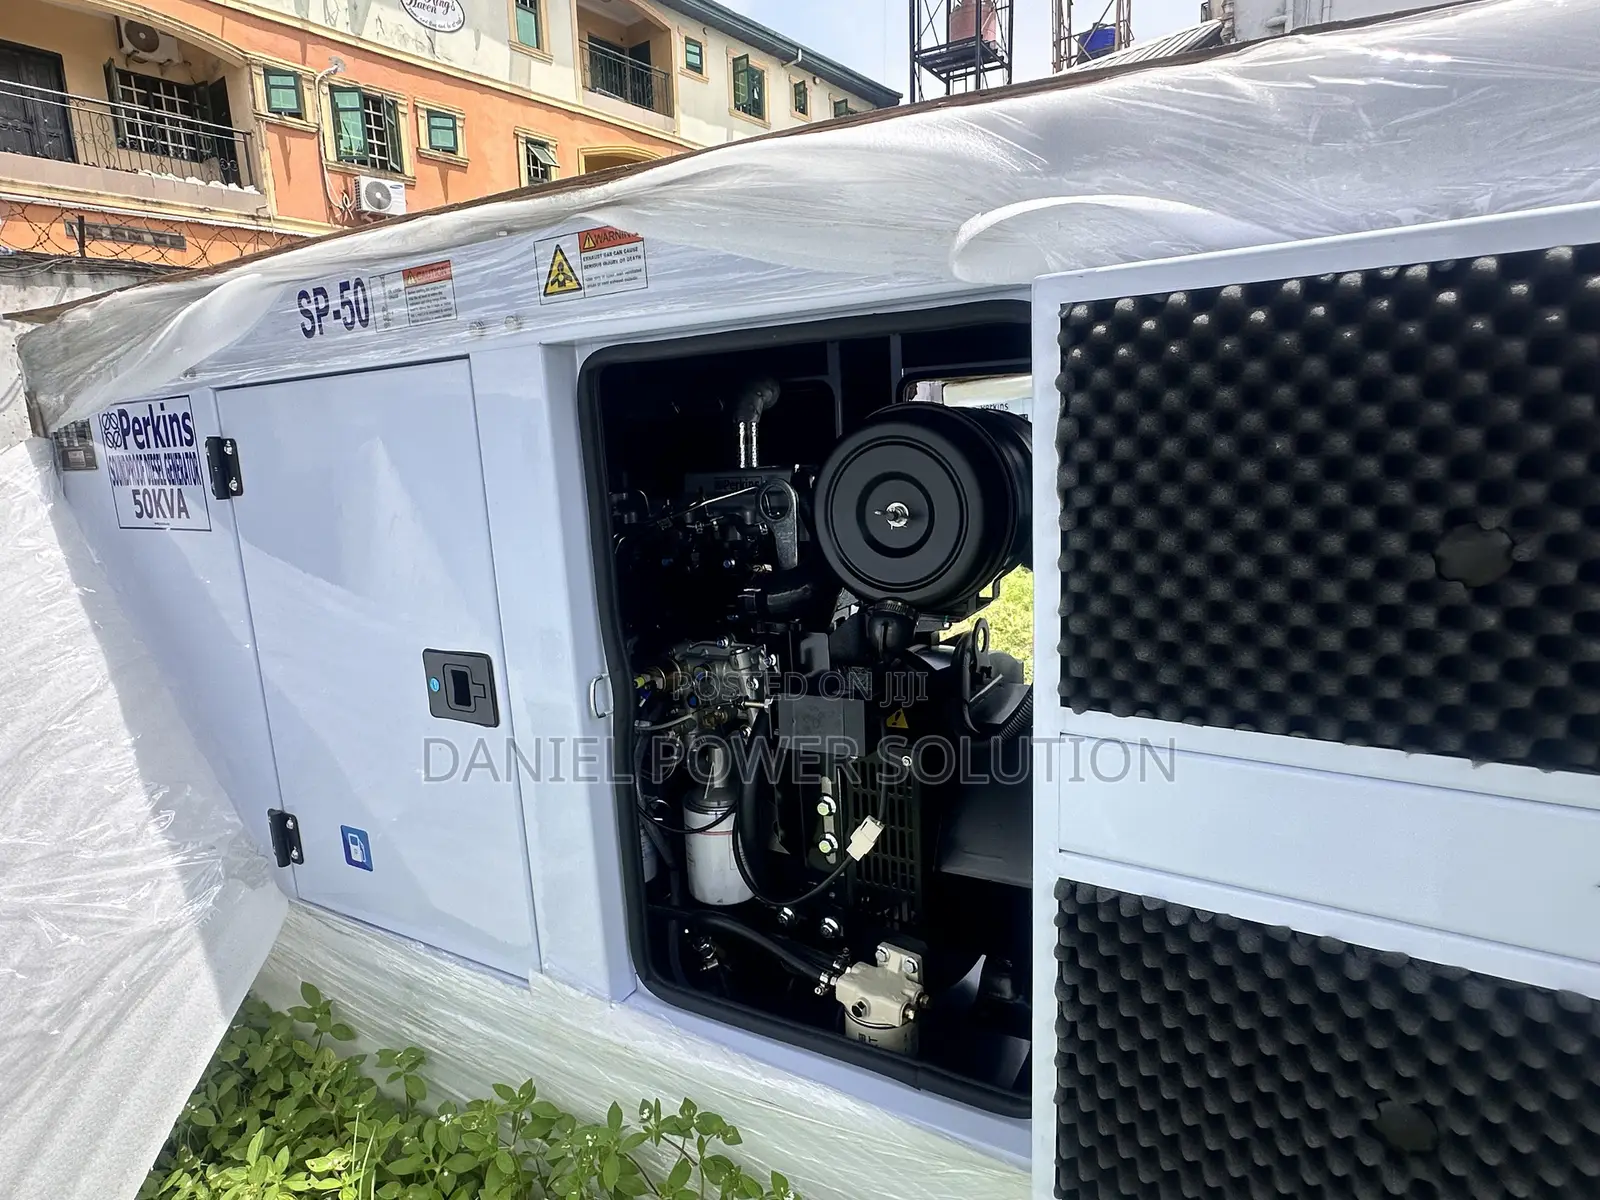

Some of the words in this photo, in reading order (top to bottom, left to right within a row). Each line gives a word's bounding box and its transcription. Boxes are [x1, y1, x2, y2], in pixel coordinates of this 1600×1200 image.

[297, 277, 370, 339] SP-50
[117, 402, 194, 450] Perkins
[132, 487, 190, 519] 50KVA
